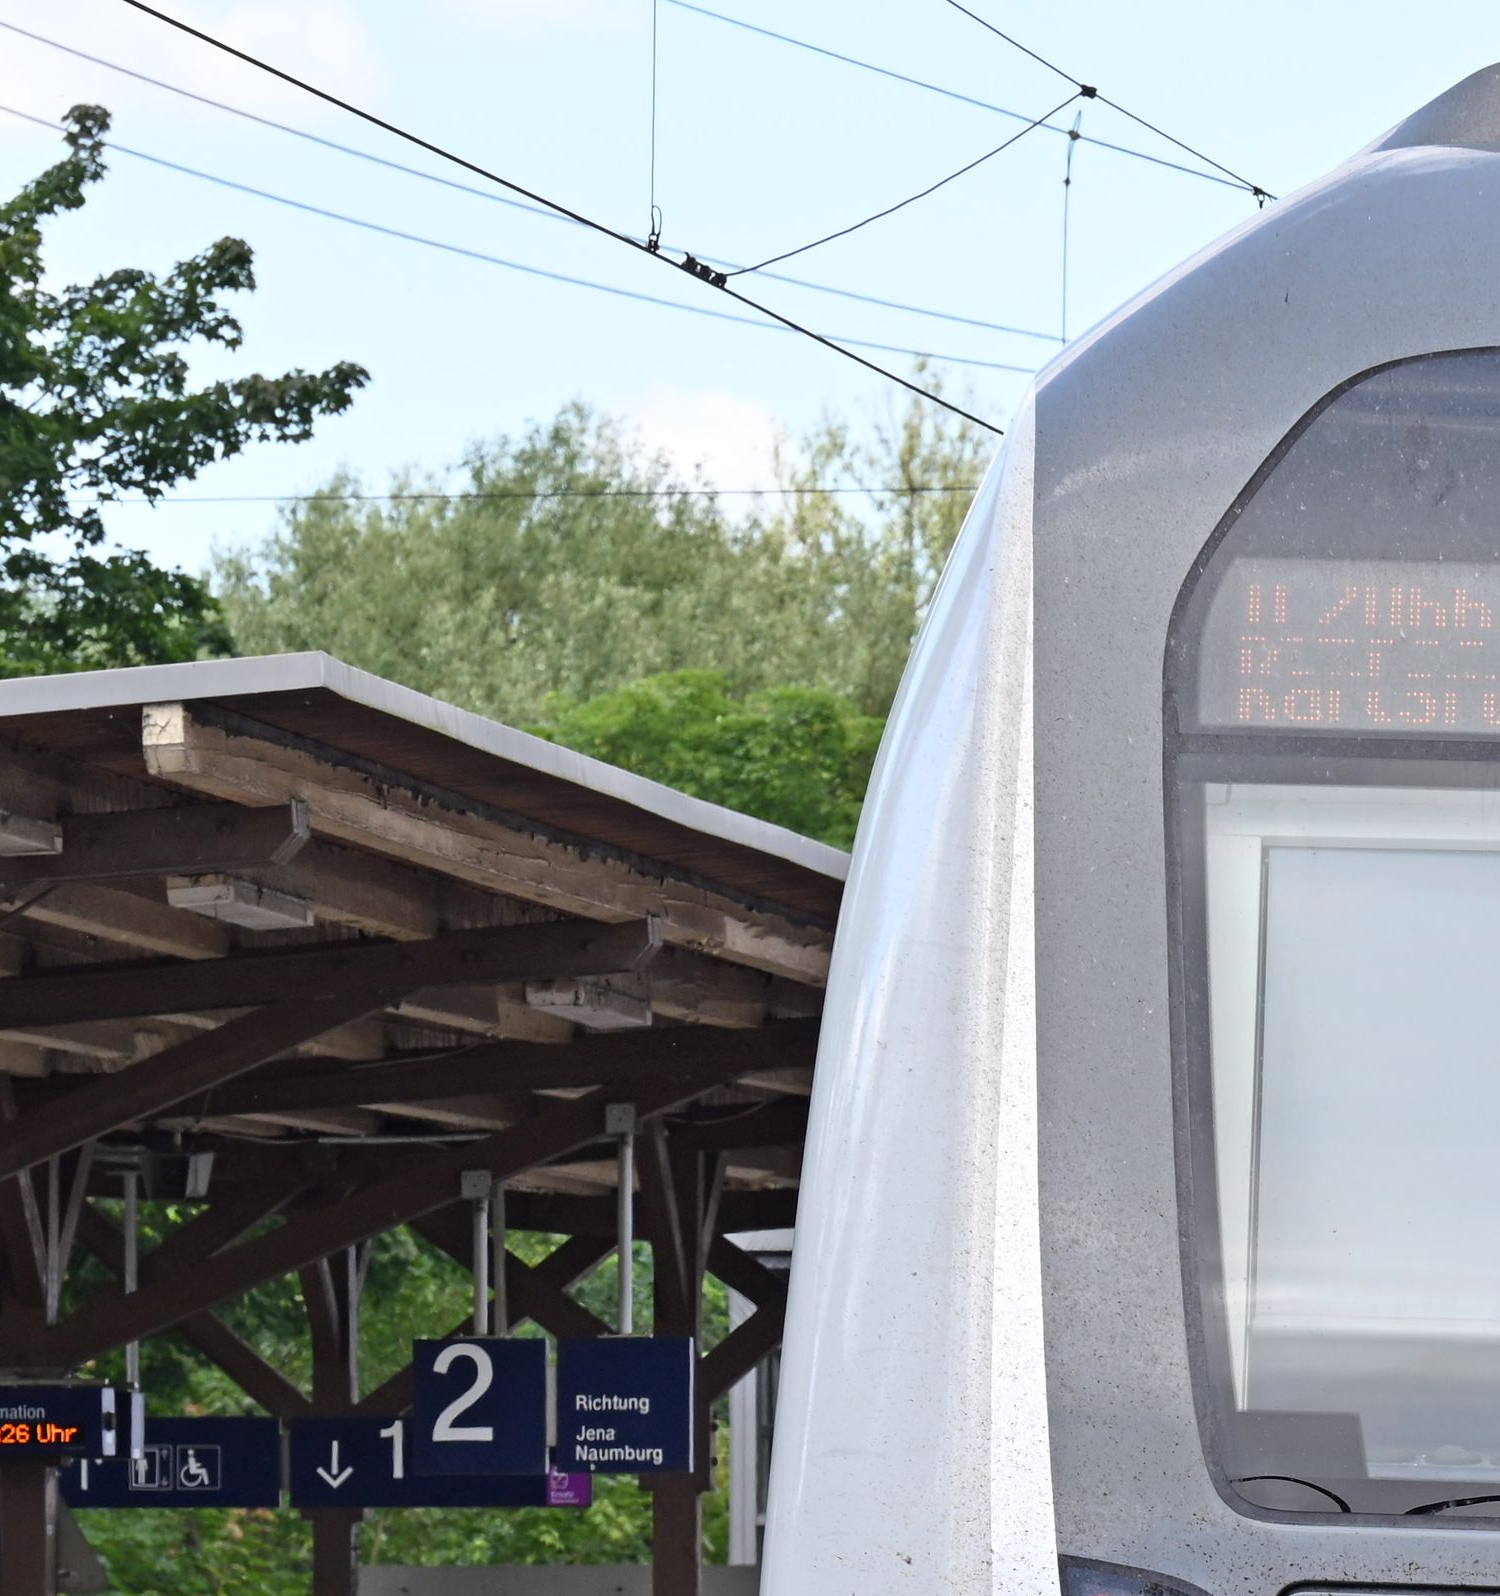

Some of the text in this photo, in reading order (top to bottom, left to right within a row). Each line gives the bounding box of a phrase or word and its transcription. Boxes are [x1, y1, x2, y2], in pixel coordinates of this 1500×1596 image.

[432, 1343, 493, 1442] 2
[575, 1395, 650, 1415] Richtung
[36, 1424, 77, 1443] Uhr
[575, 1425, 616, 1441] Jena
[379, 1420, 404, 1479] 1
[575, 1445, 663, 1464] Naumburg
